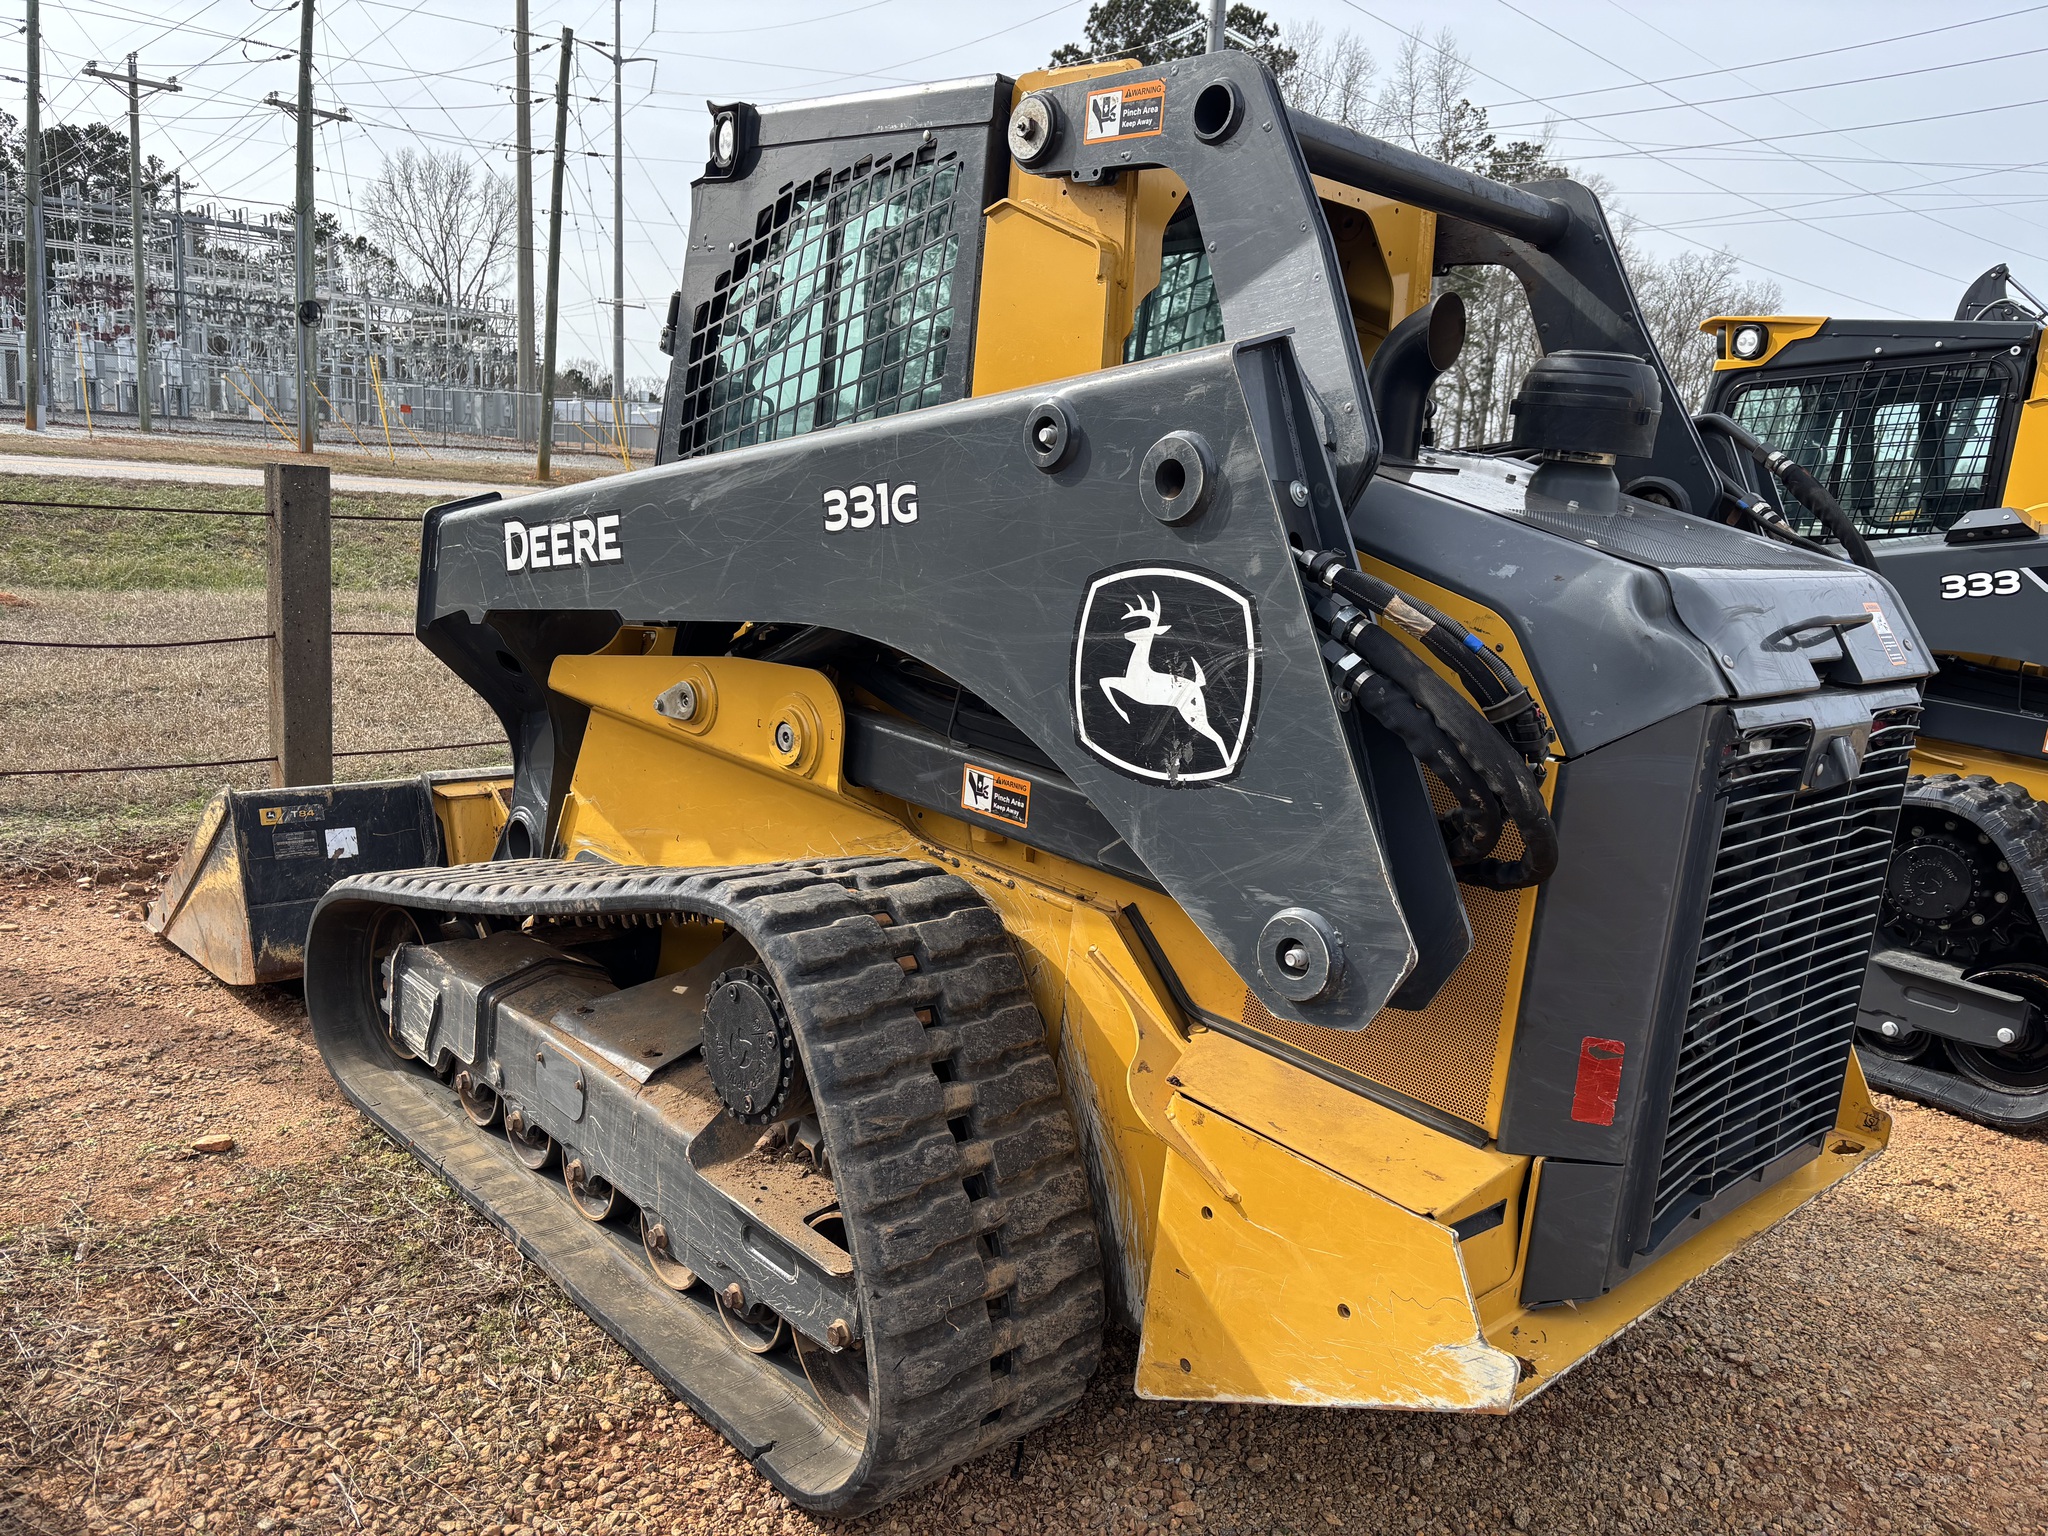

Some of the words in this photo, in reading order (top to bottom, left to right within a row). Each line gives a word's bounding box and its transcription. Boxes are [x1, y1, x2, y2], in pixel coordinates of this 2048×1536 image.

[1132, 85, 1162, 97] WARNING
[1123, 108, 1142, 117] Pinch
[1142, 106, 1158, 114] Area
[823, 483, 918, 532] 331G
[504, 514, 622, 571] DEERE
[1941, 570, 2021, 599] 333
[1001, 779, 1026, 792] WARNING
[994, 793, 1010, 803] Pinch
[1011, 798, 1024, 808] Area
[993, 803, 1006, 812] Keep
[1006, 807, 1019, 816] Away
